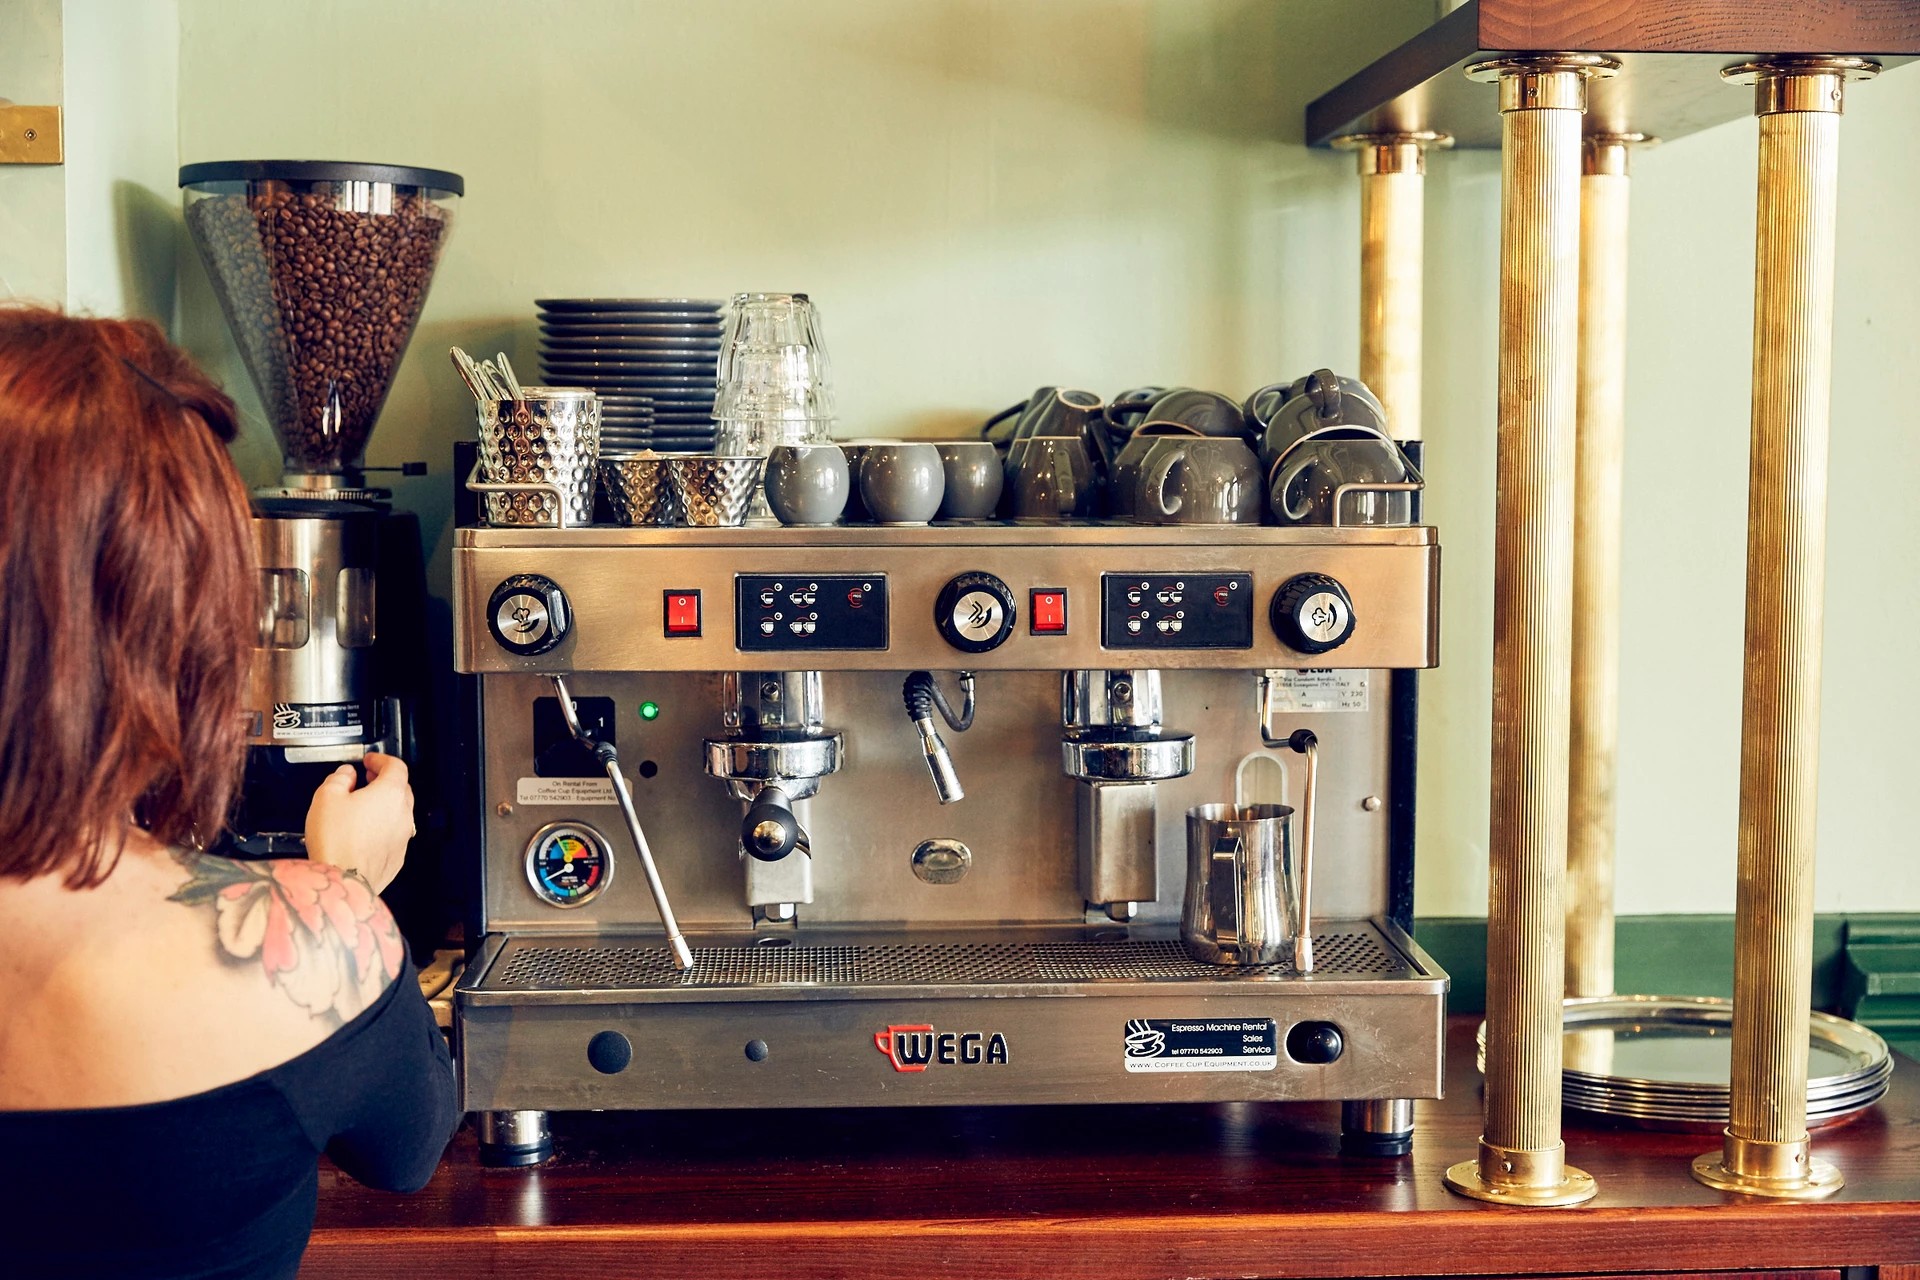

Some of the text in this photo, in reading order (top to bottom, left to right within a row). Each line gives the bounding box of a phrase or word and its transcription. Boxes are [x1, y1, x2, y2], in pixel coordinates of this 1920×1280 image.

[598, 716, 604, 728] 1
[1171, 1022, 1268, 1033] Espresso Machine Rental
[1242, 1034, 1264, 1043] Sales
[897, 1032, 1009, 1065] WEGA
[1199, 1047, 1223, 1055] 542903
[1242, 1045, 1272, 1054] Service
